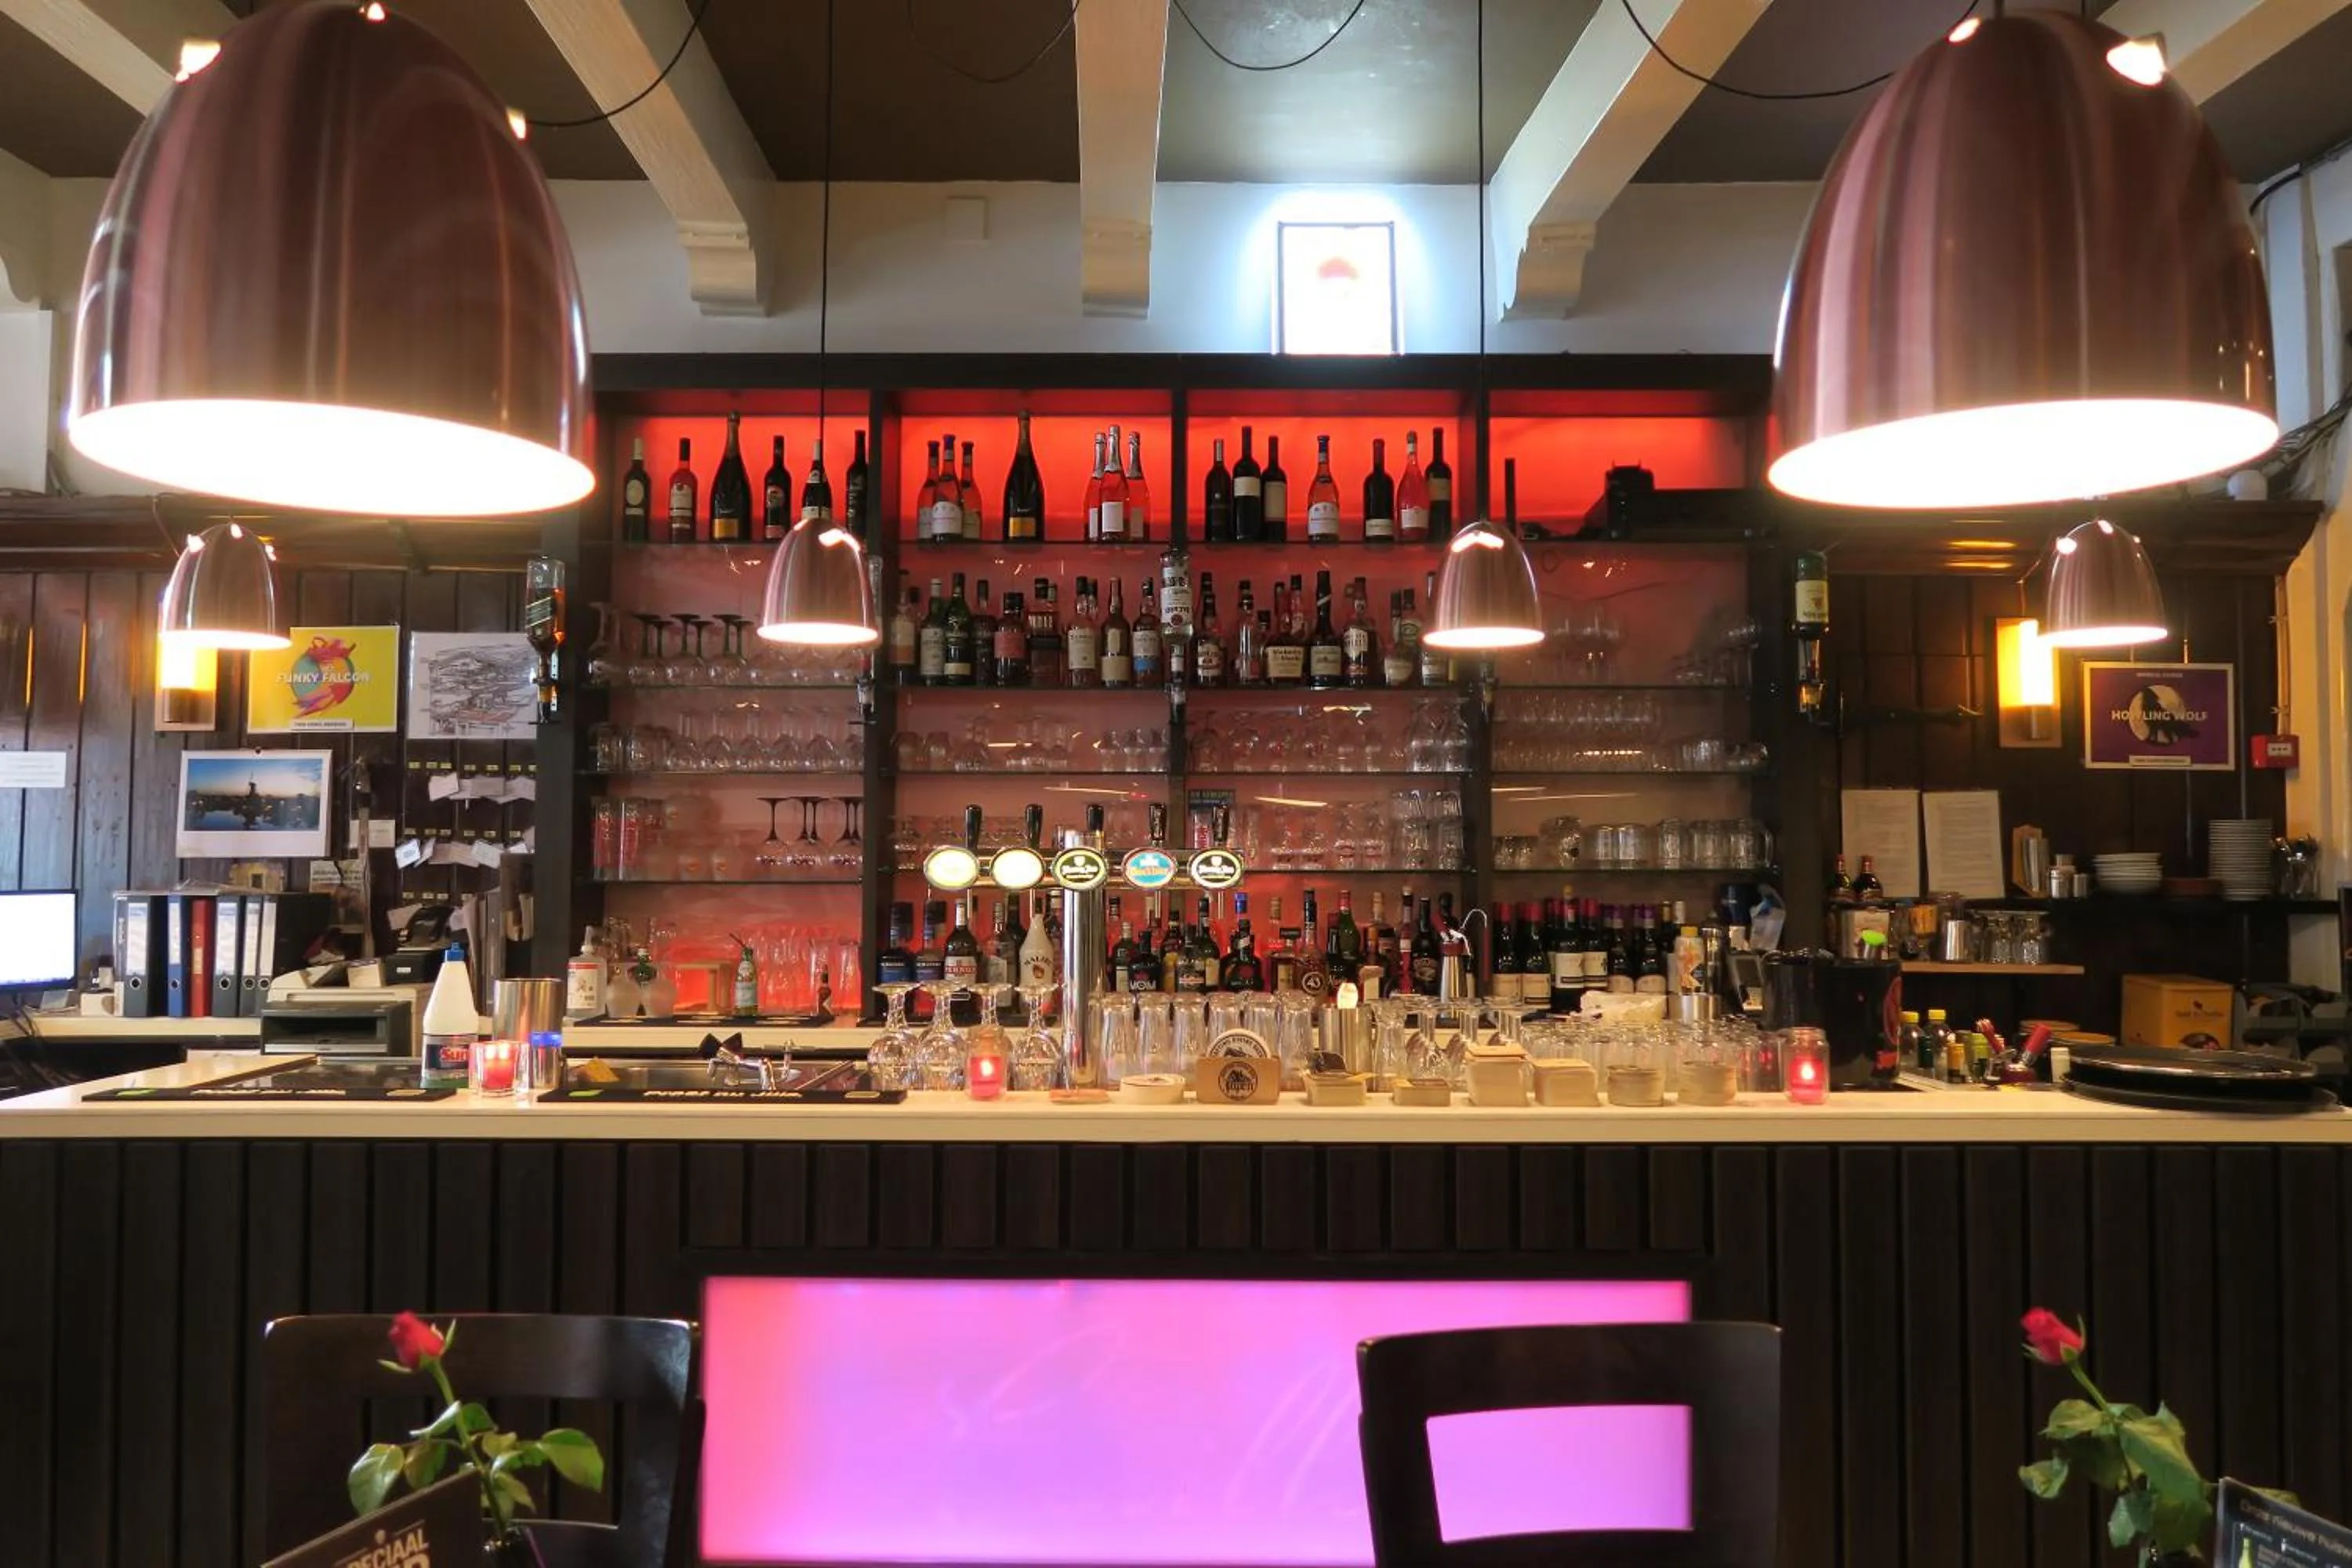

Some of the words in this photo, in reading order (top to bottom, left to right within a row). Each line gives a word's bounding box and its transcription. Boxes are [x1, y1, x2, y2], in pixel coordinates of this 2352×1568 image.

[277, 673, 319, 683] FUNKY
[322, 672, 370, 682] FALCON
[2111, 710, 2171, 720] HOLING
[2175, 710, 2208, 720] WOLF
